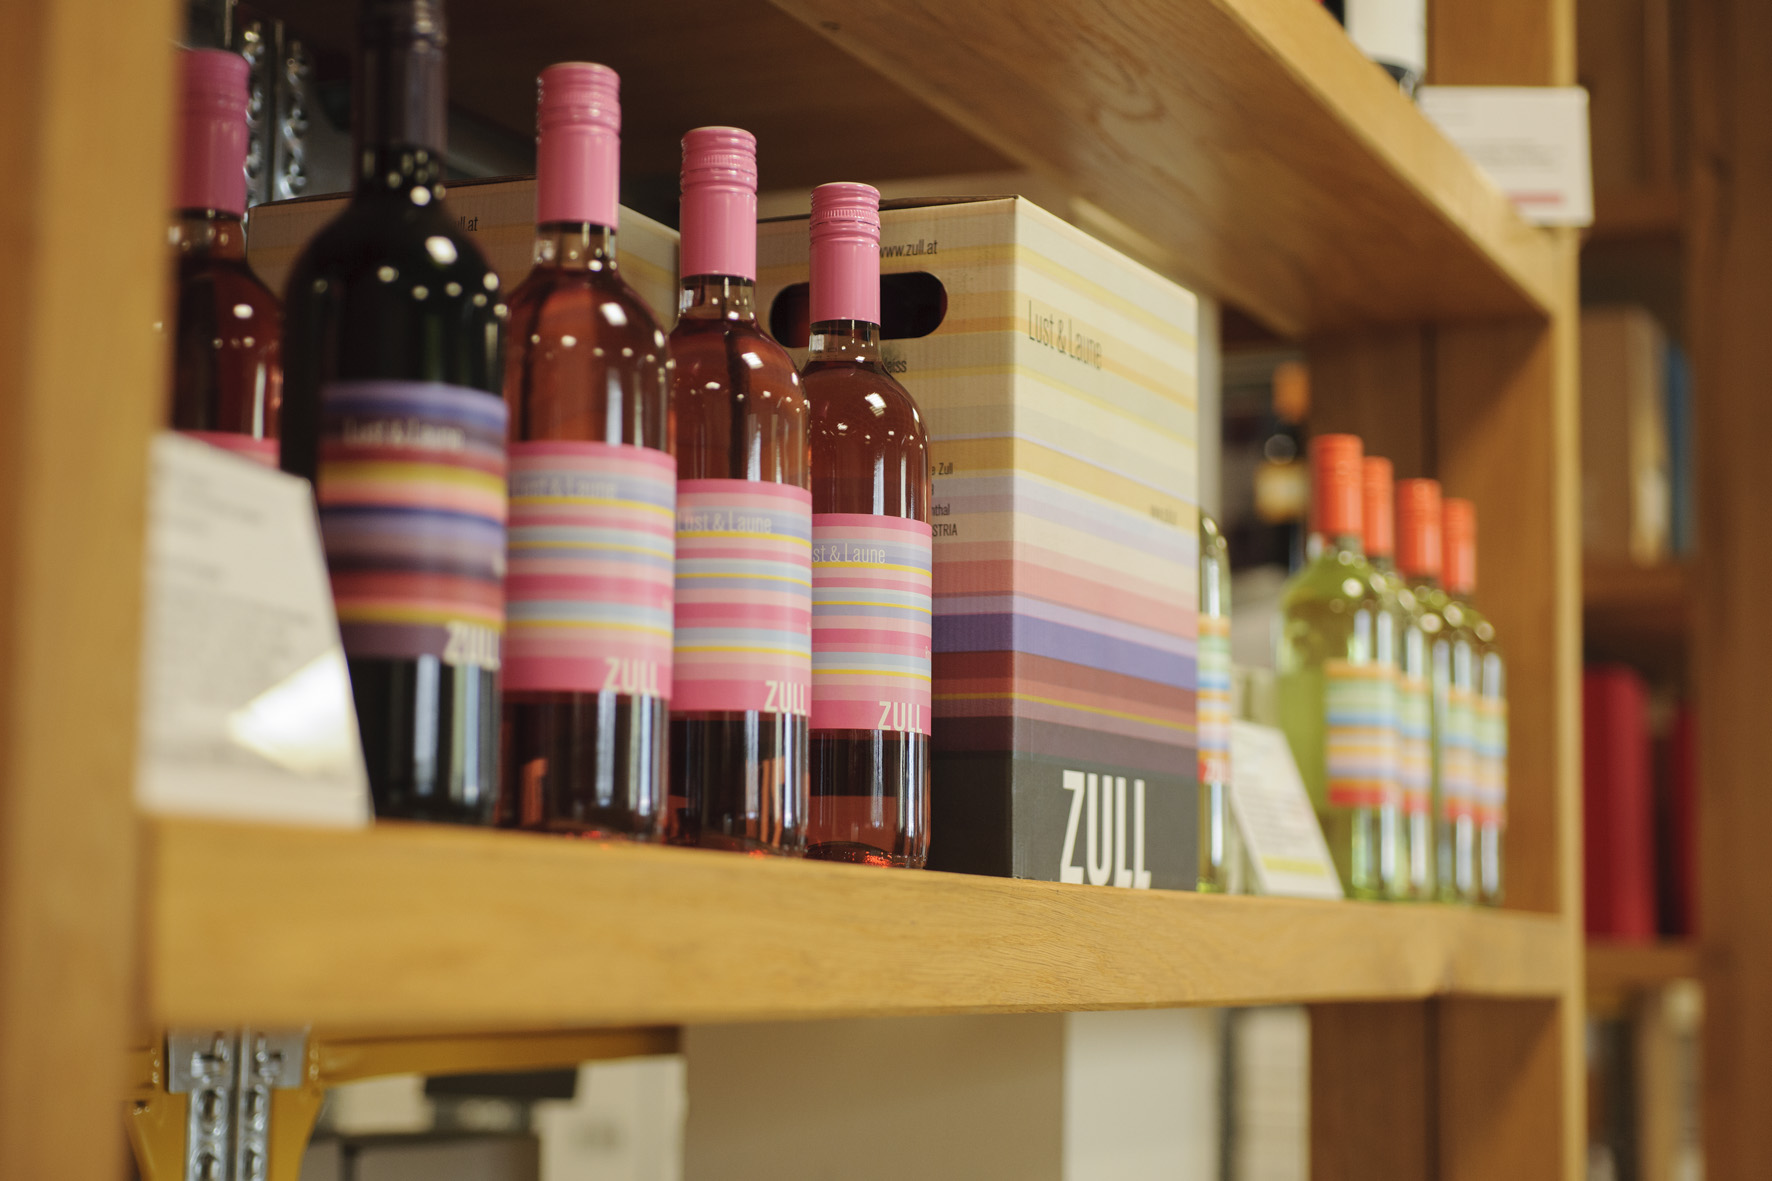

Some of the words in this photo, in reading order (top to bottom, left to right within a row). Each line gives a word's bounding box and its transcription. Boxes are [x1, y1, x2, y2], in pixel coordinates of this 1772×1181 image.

[1028, 299, 1054, 350] Lust
[1057, 319, 1067, 355] &
[1068, 318, 1102, 371] Laune
[939, 462, 954, 475] Zull
[677, 511, 709, 532] Lust
[712, 512, 725, 532] &
[728, 510, 772, 534] Laune
[829, 545, 840, 562] &
[844, 543, 885, 564] Laune
[443, 620, 501, 672] ZULL
[603, 656, 660, 697] ZULL
[763, 680, 806, 716] ZULL
[877, 701, 923, 734] ZULL
[1059, 768, 1152, 889] ZULL
